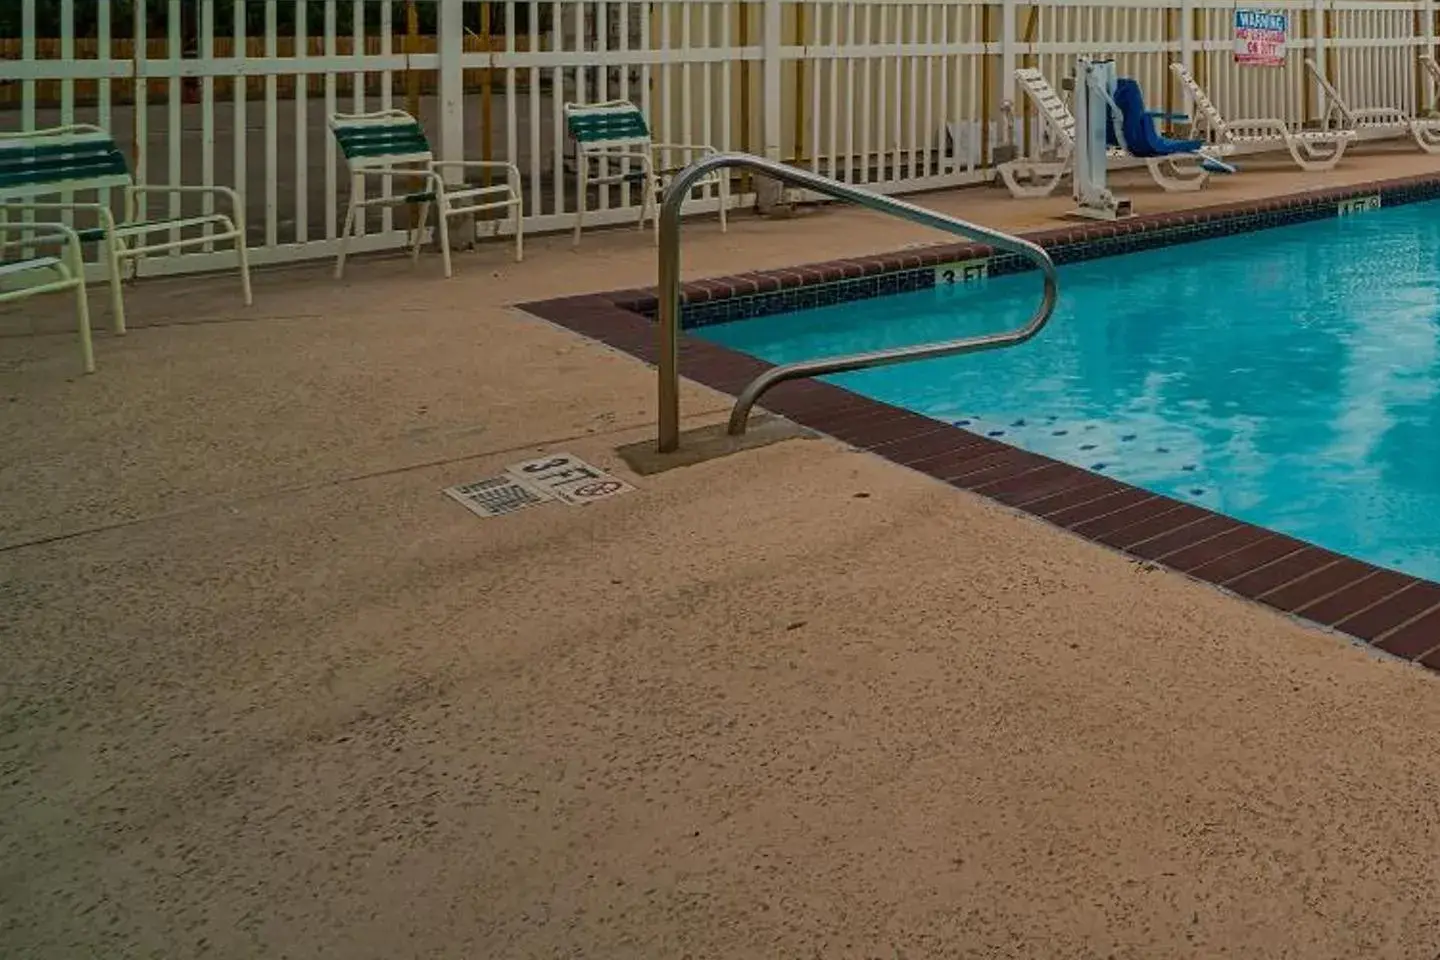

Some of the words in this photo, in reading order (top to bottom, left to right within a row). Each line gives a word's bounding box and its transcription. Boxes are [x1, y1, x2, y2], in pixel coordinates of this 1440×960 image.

[963, 264, 985, 283] FT
[522, 458, 570, 473] 3
[536, 466, 600, 487] FT
